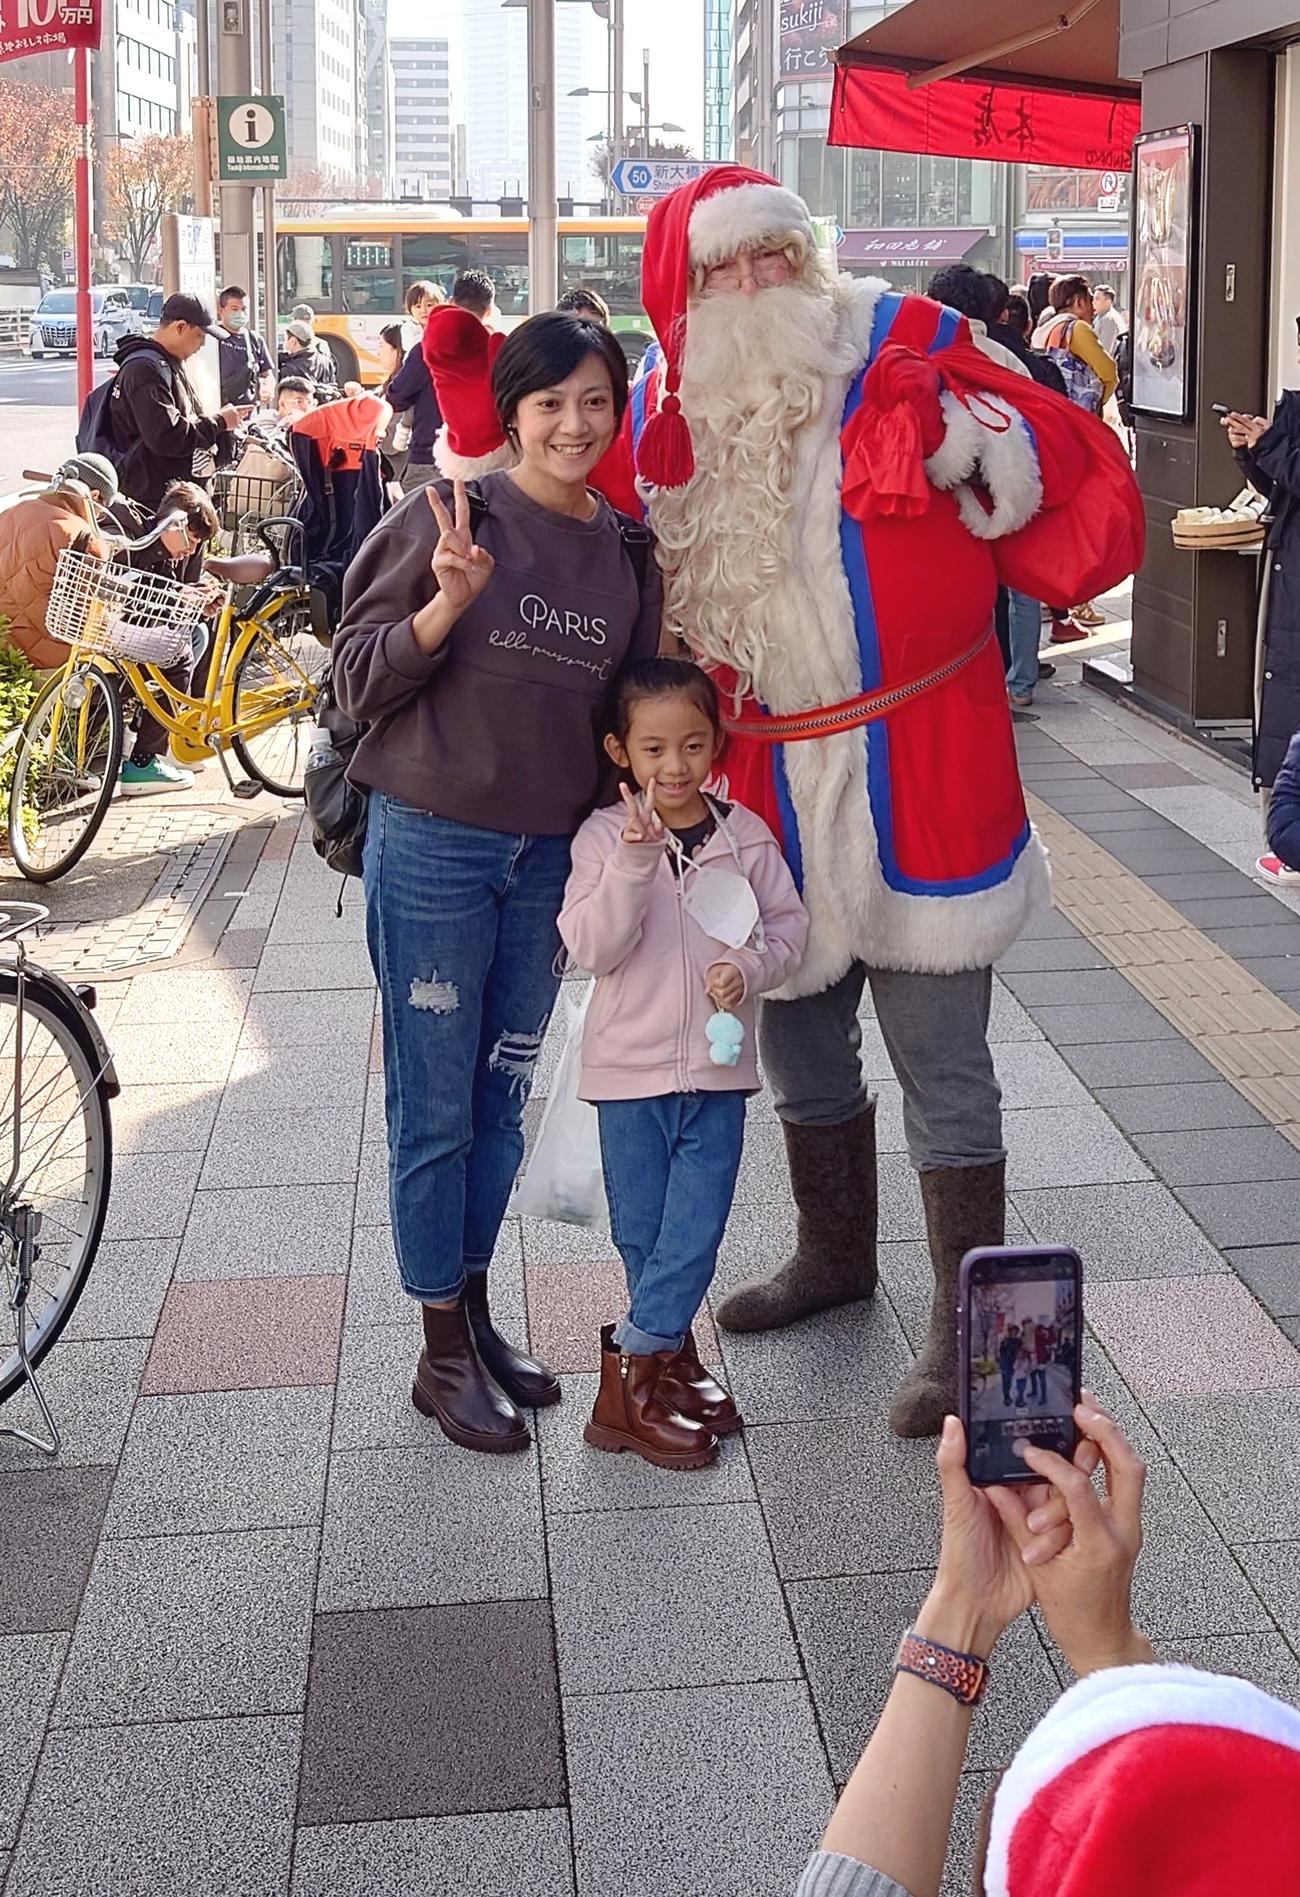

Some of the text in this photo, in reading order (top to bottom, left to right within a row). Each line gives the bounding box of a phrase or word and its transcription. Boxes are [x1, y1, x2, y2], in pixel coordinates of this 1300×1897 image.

[785, 46, 829, 71] 行こう
[632, 170, 647, 184] 50
[520, 594, 607, 645] PARIS
[488, 630, 531, 650] hello
